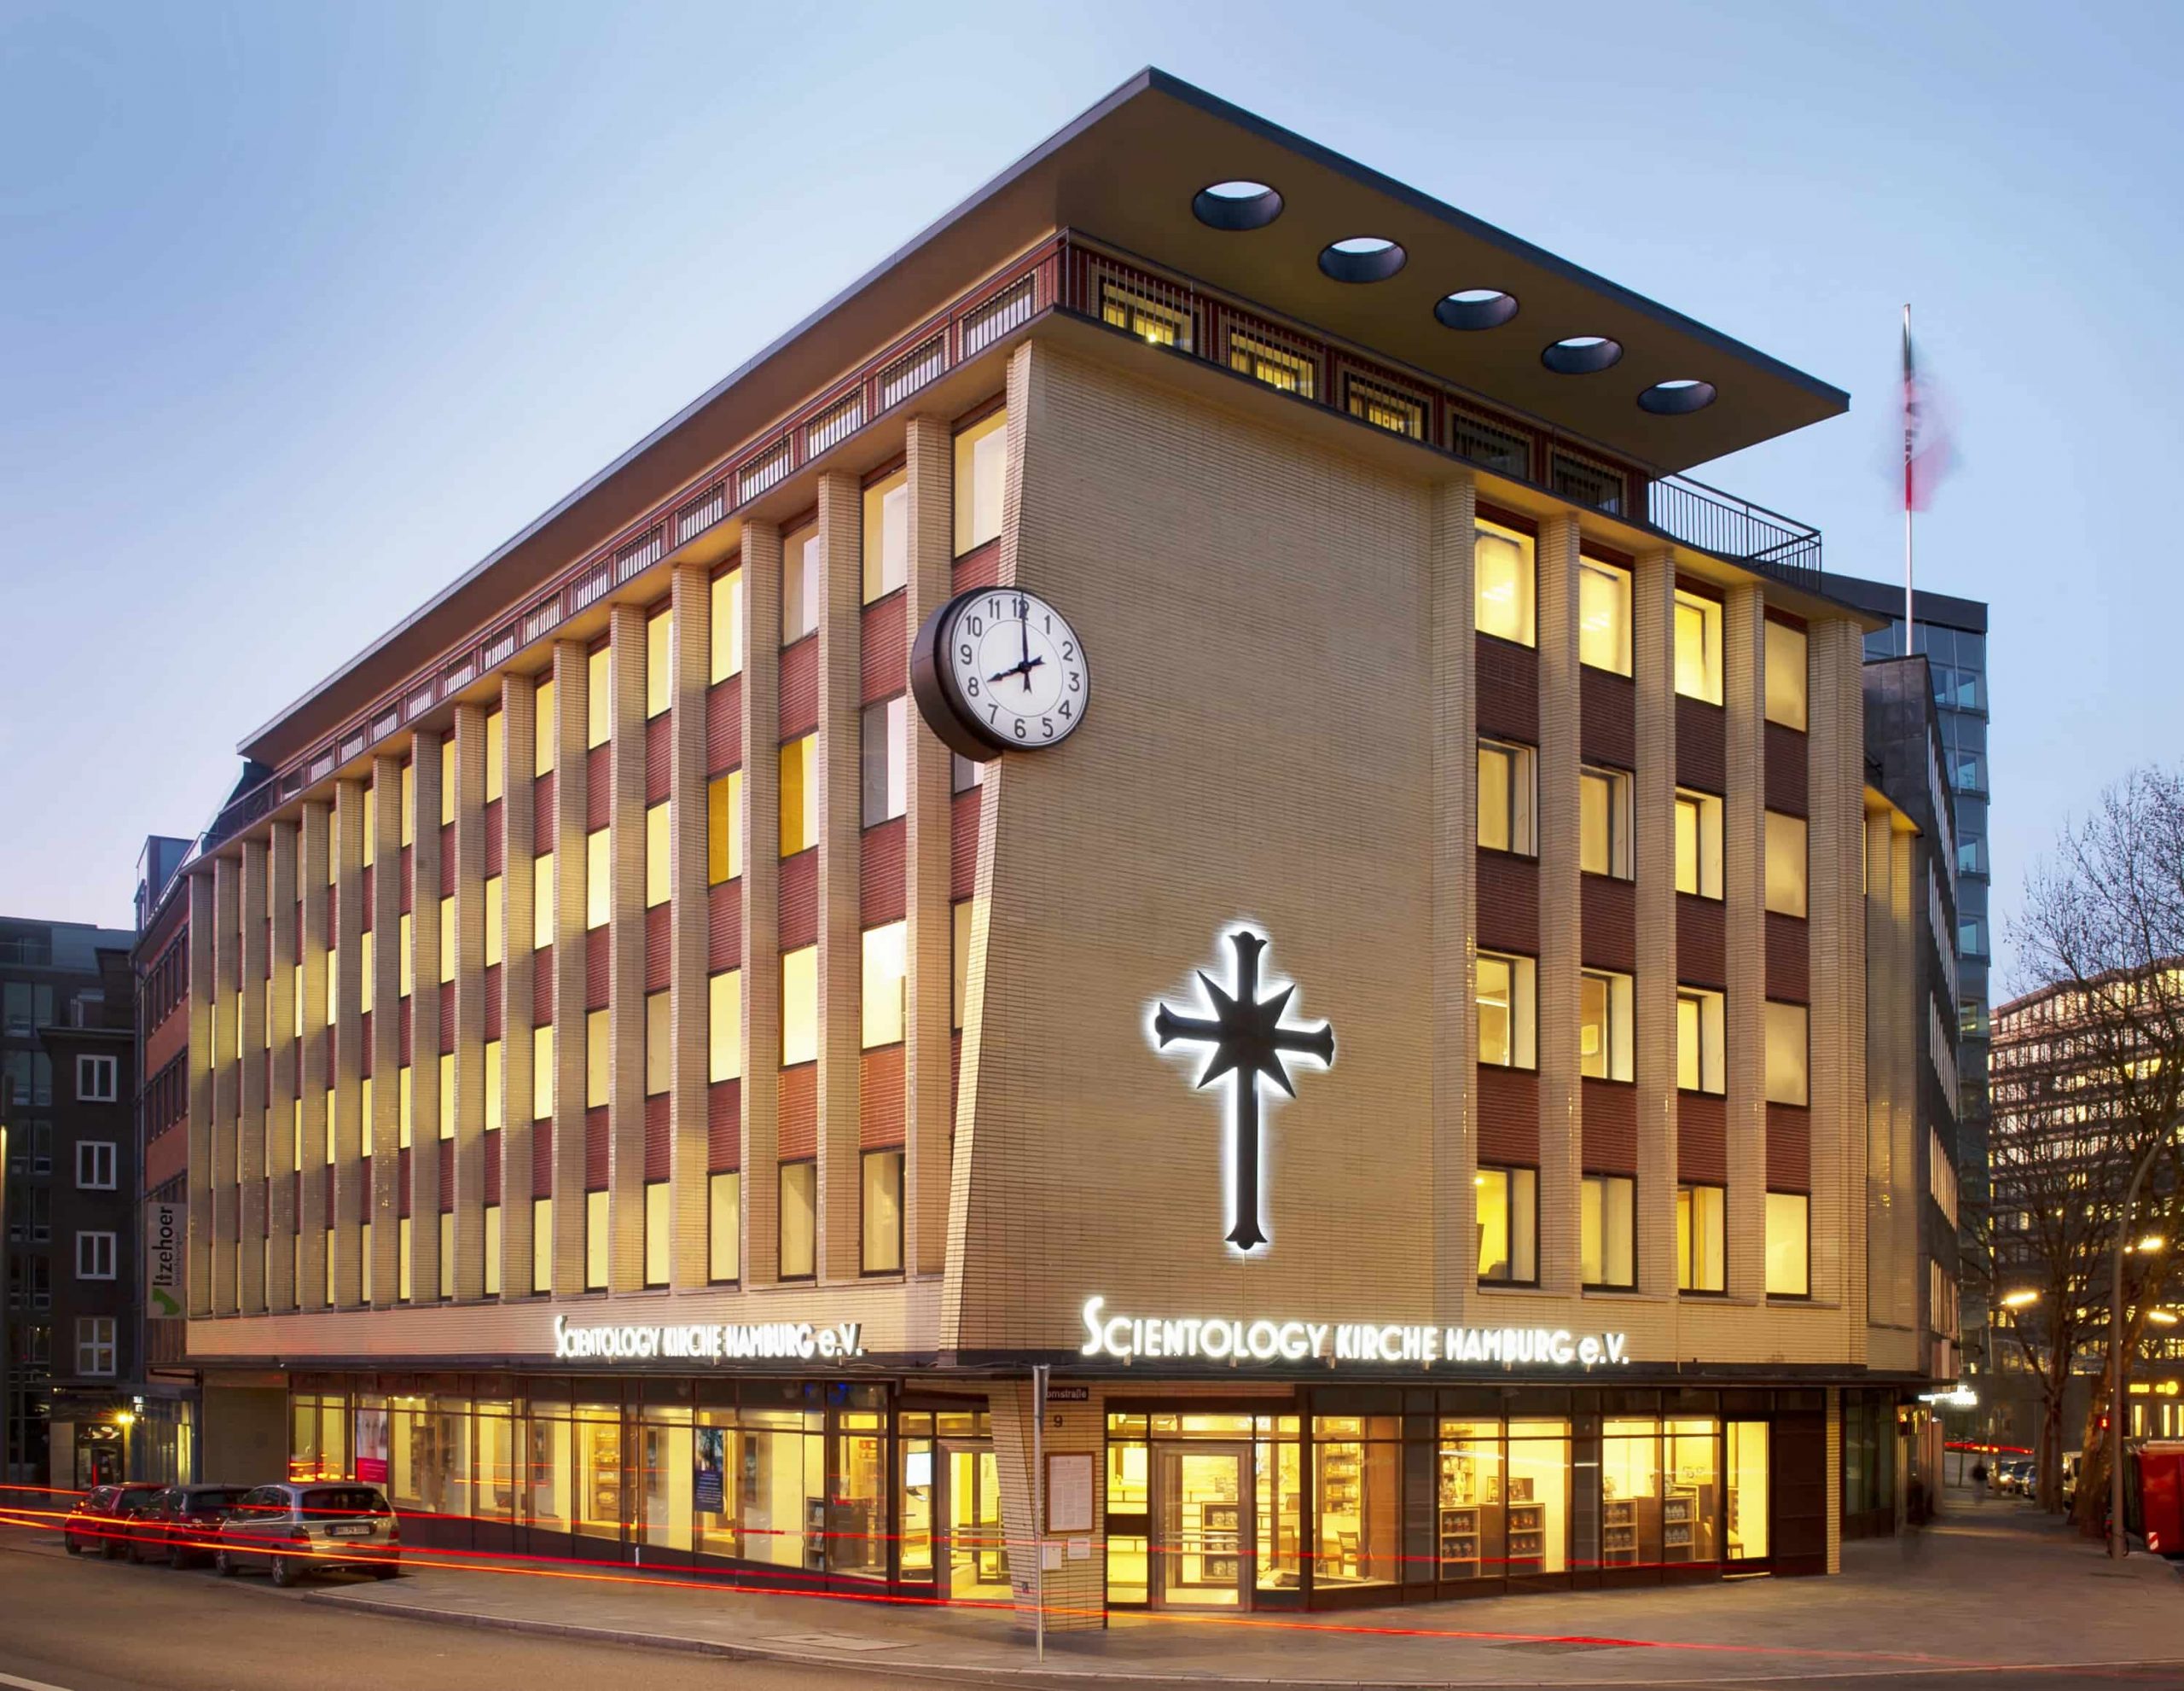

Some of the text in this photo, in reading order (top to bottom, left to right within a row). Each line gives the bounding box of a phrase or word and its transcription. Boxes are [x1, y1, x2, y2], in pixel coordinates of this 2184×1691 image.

[988, 597, 1001, 620] 11
[1012, 597, 1030, 621] 12
[966, 615, 983, 637] 10
[1044, 615, 1050, 635] 1
[960, 644, 973, 665] 9
[1062, 641, 1074, 661] 2
[967, 677, 979, 697] 8
[1068, 671, 1080, 693] 3
[988, 703, 998, 724] 7
[1058, 700, 1072, 720] 4
[1014, 718, 1026, 739] 6
[1042, 718, 1054, 738] 5
[152, 1206, 173, 1286] Itzehoer
[818, 1322, 863, 1357] e.V.
[1080, 1294, 1630, 1366] SCIENTOLOGY KIRCHE HAMBURG e.V.
[1046, 1388, 1087, 1398] omstraße
[1054, 1415, 1063, 1427] 9
